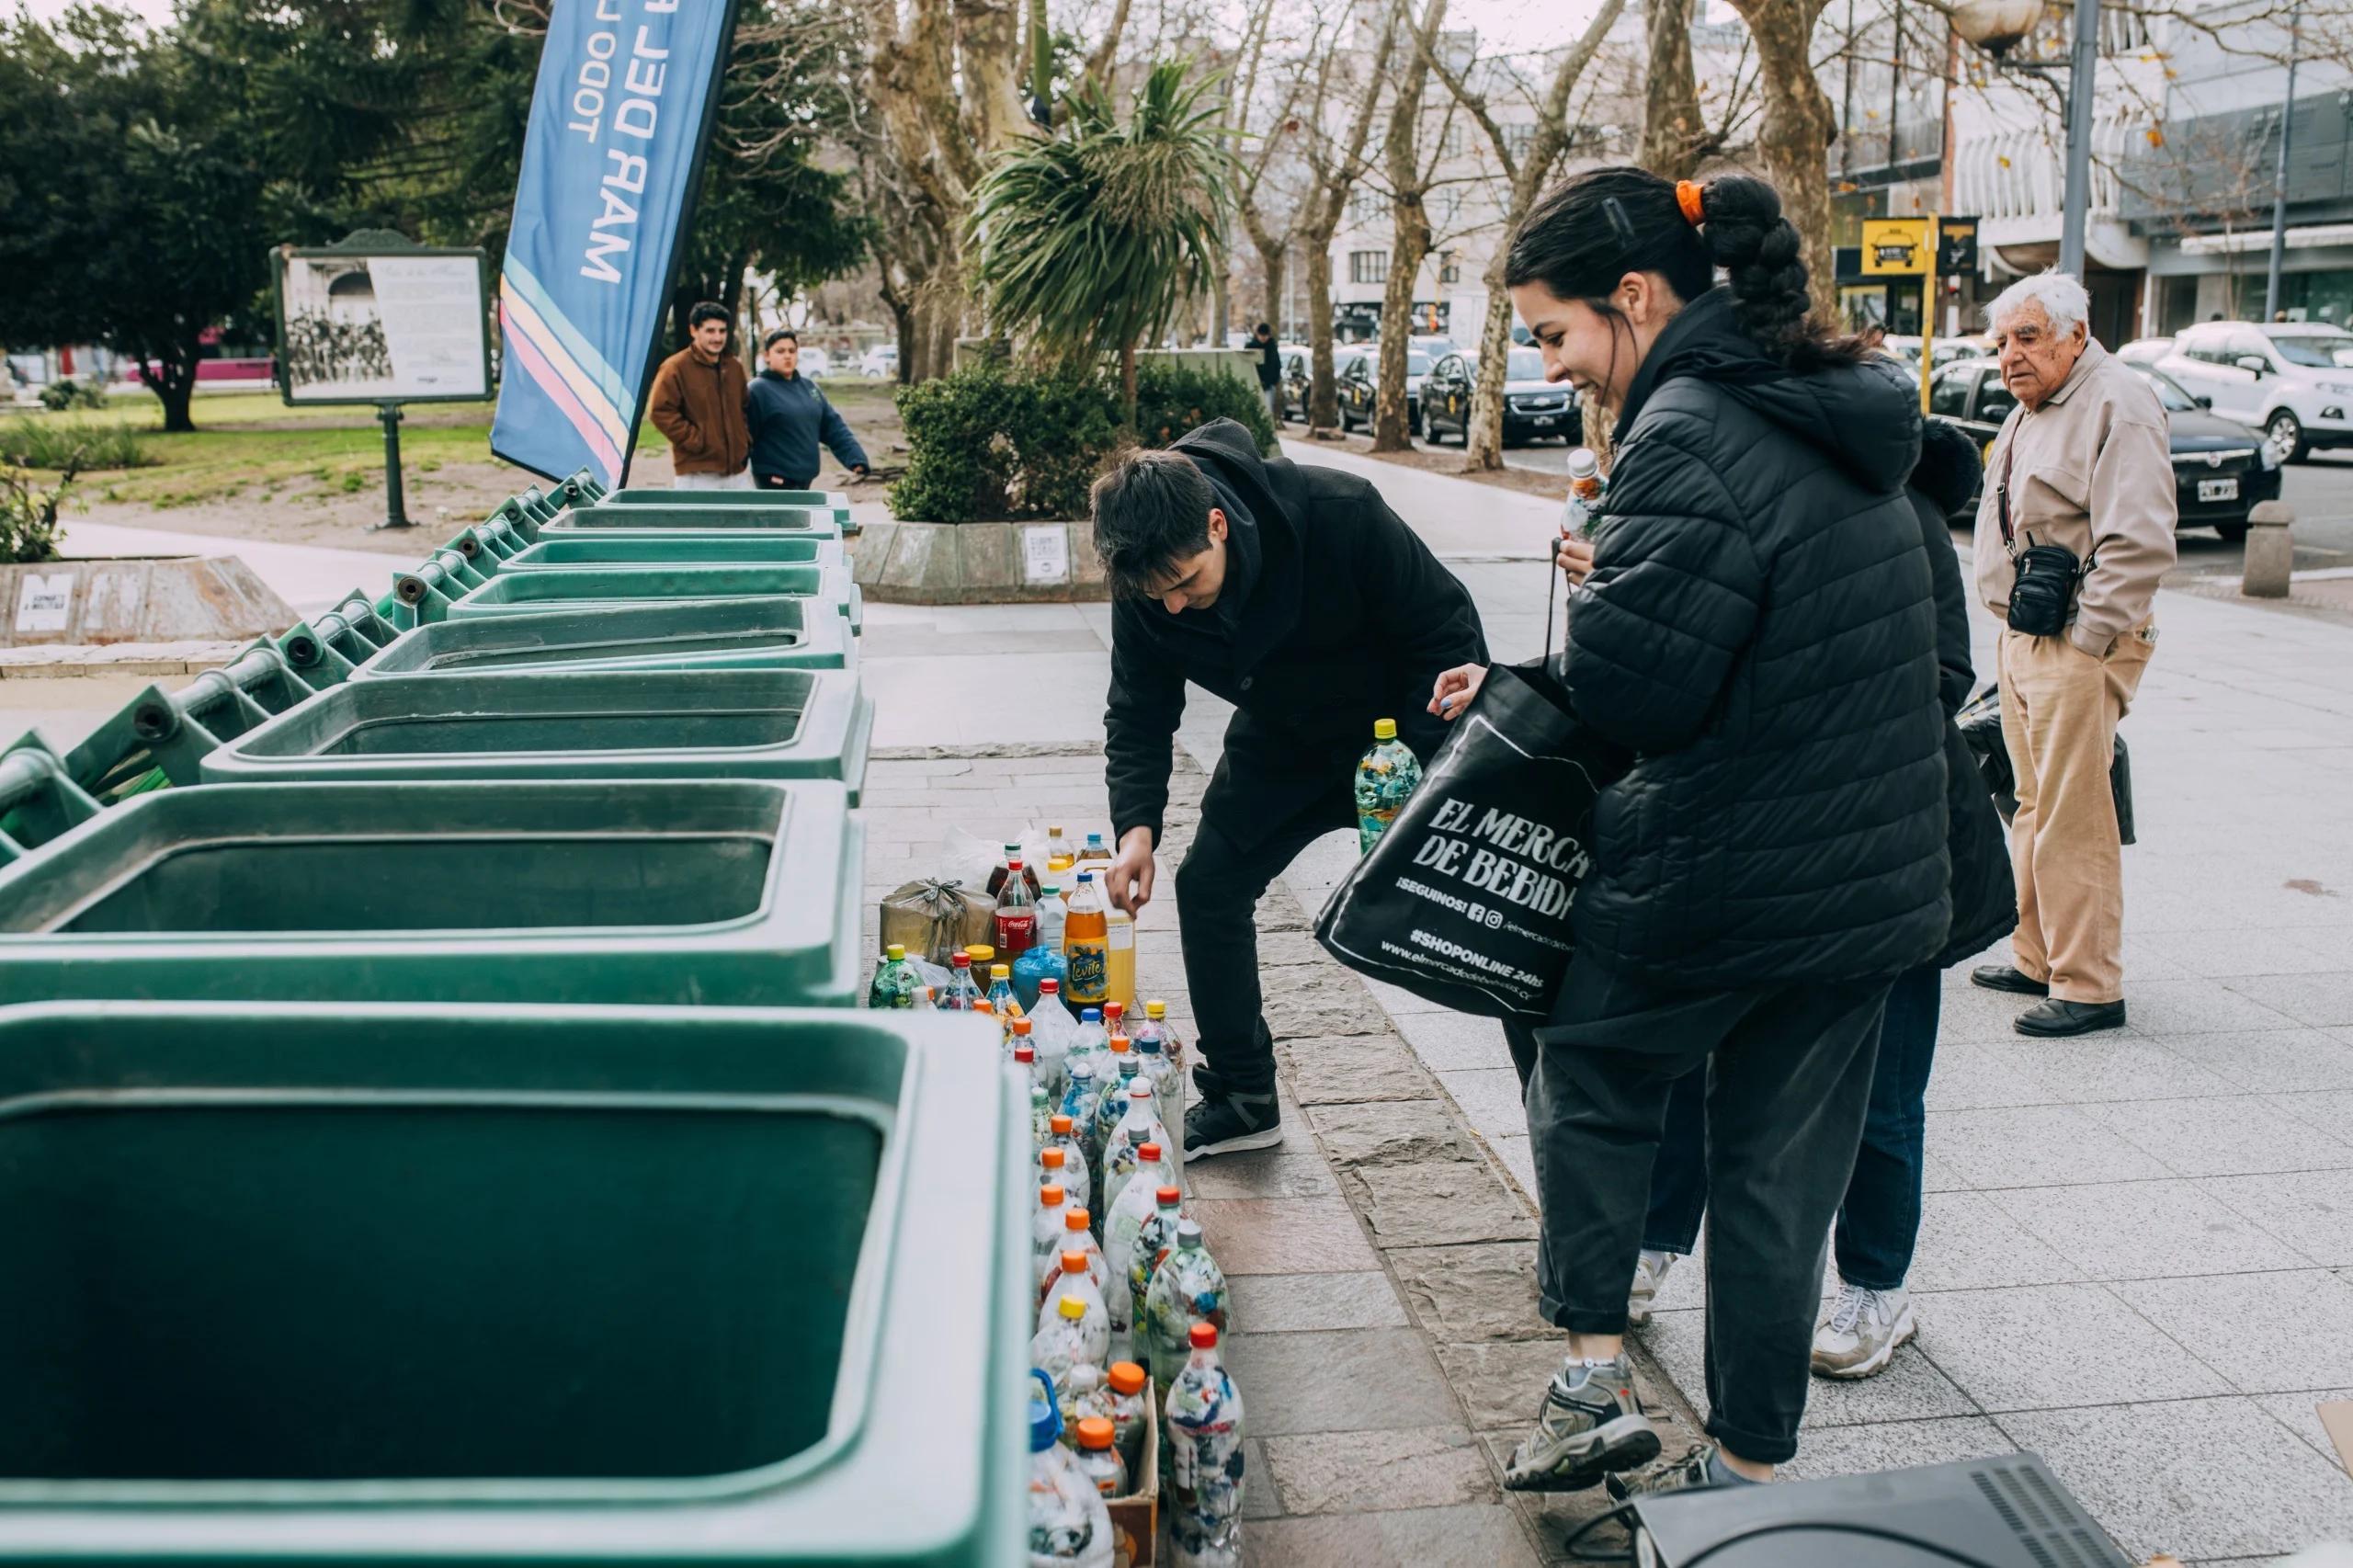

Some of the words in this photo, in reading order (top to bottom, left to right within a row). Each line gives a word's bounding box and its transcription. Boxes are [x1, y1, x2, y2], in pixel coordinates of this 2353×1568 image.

[1428, 798, 1474, 833] EL
[1412, 835, 1470, 877] DE
[1410, 928, 1515, 978] #SHOPONLINE
[1512, 971, 1544, 988] 24hs
